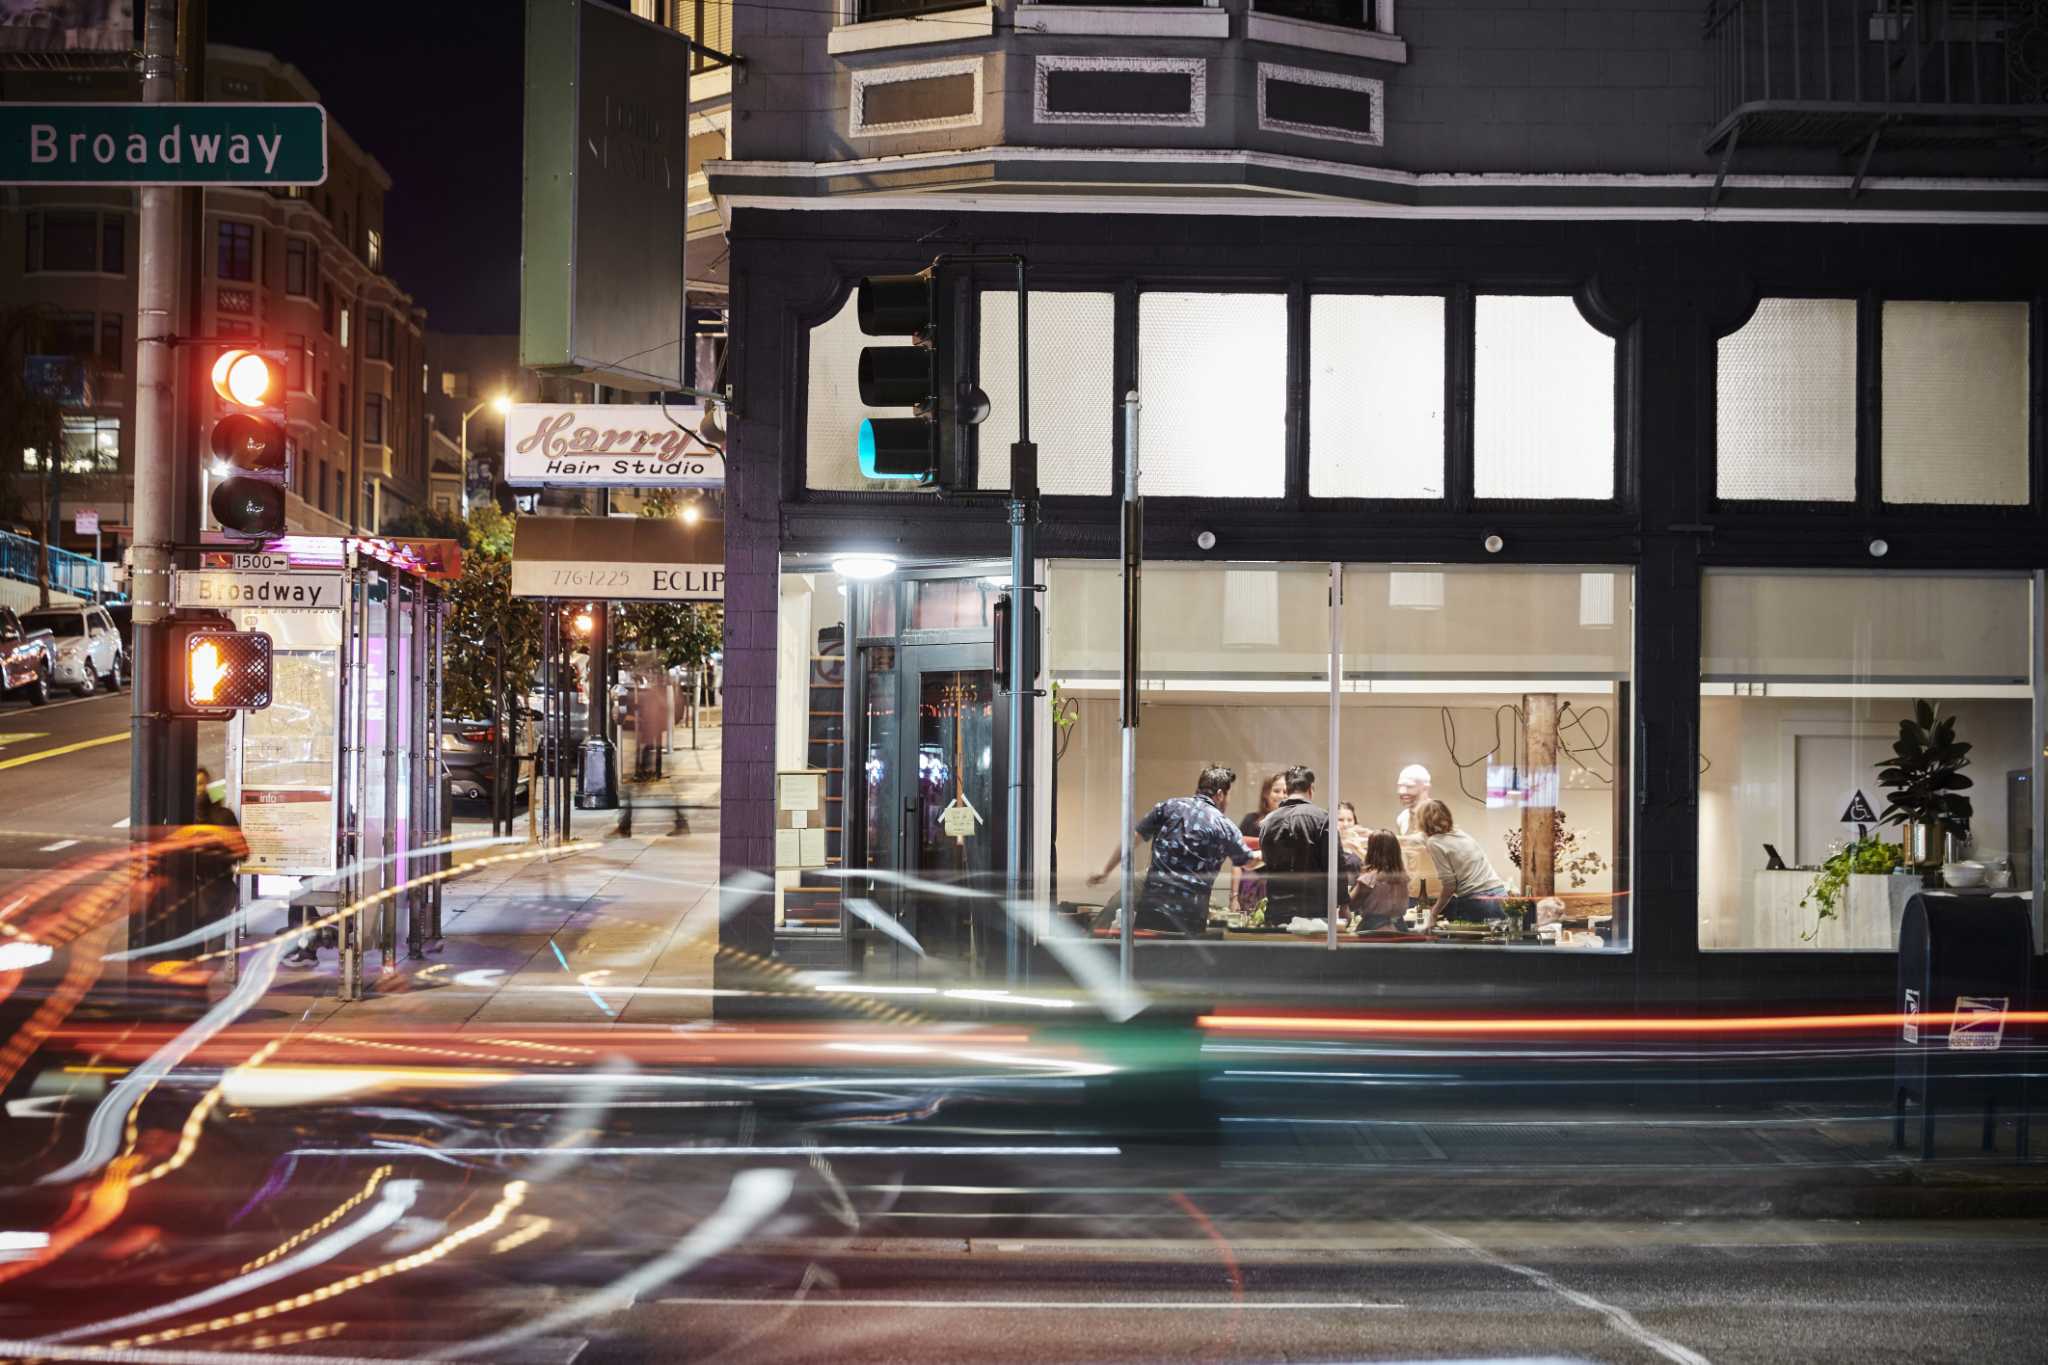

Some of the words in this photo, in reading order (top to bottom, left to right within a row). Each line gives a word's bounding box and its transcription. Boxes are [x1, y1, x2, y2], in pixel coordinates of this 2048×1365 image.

[31, 123, 282, 174] Broadway
[516, 411, 724, 462] Harry
[546, 460, 600, 475] Hair
[612, 460, 705, 475] Studio
[236, 555, 272, 569] 1500
[552, 569, 630, 586] 776-1225
[200, 580, 322, 606] Broadway
